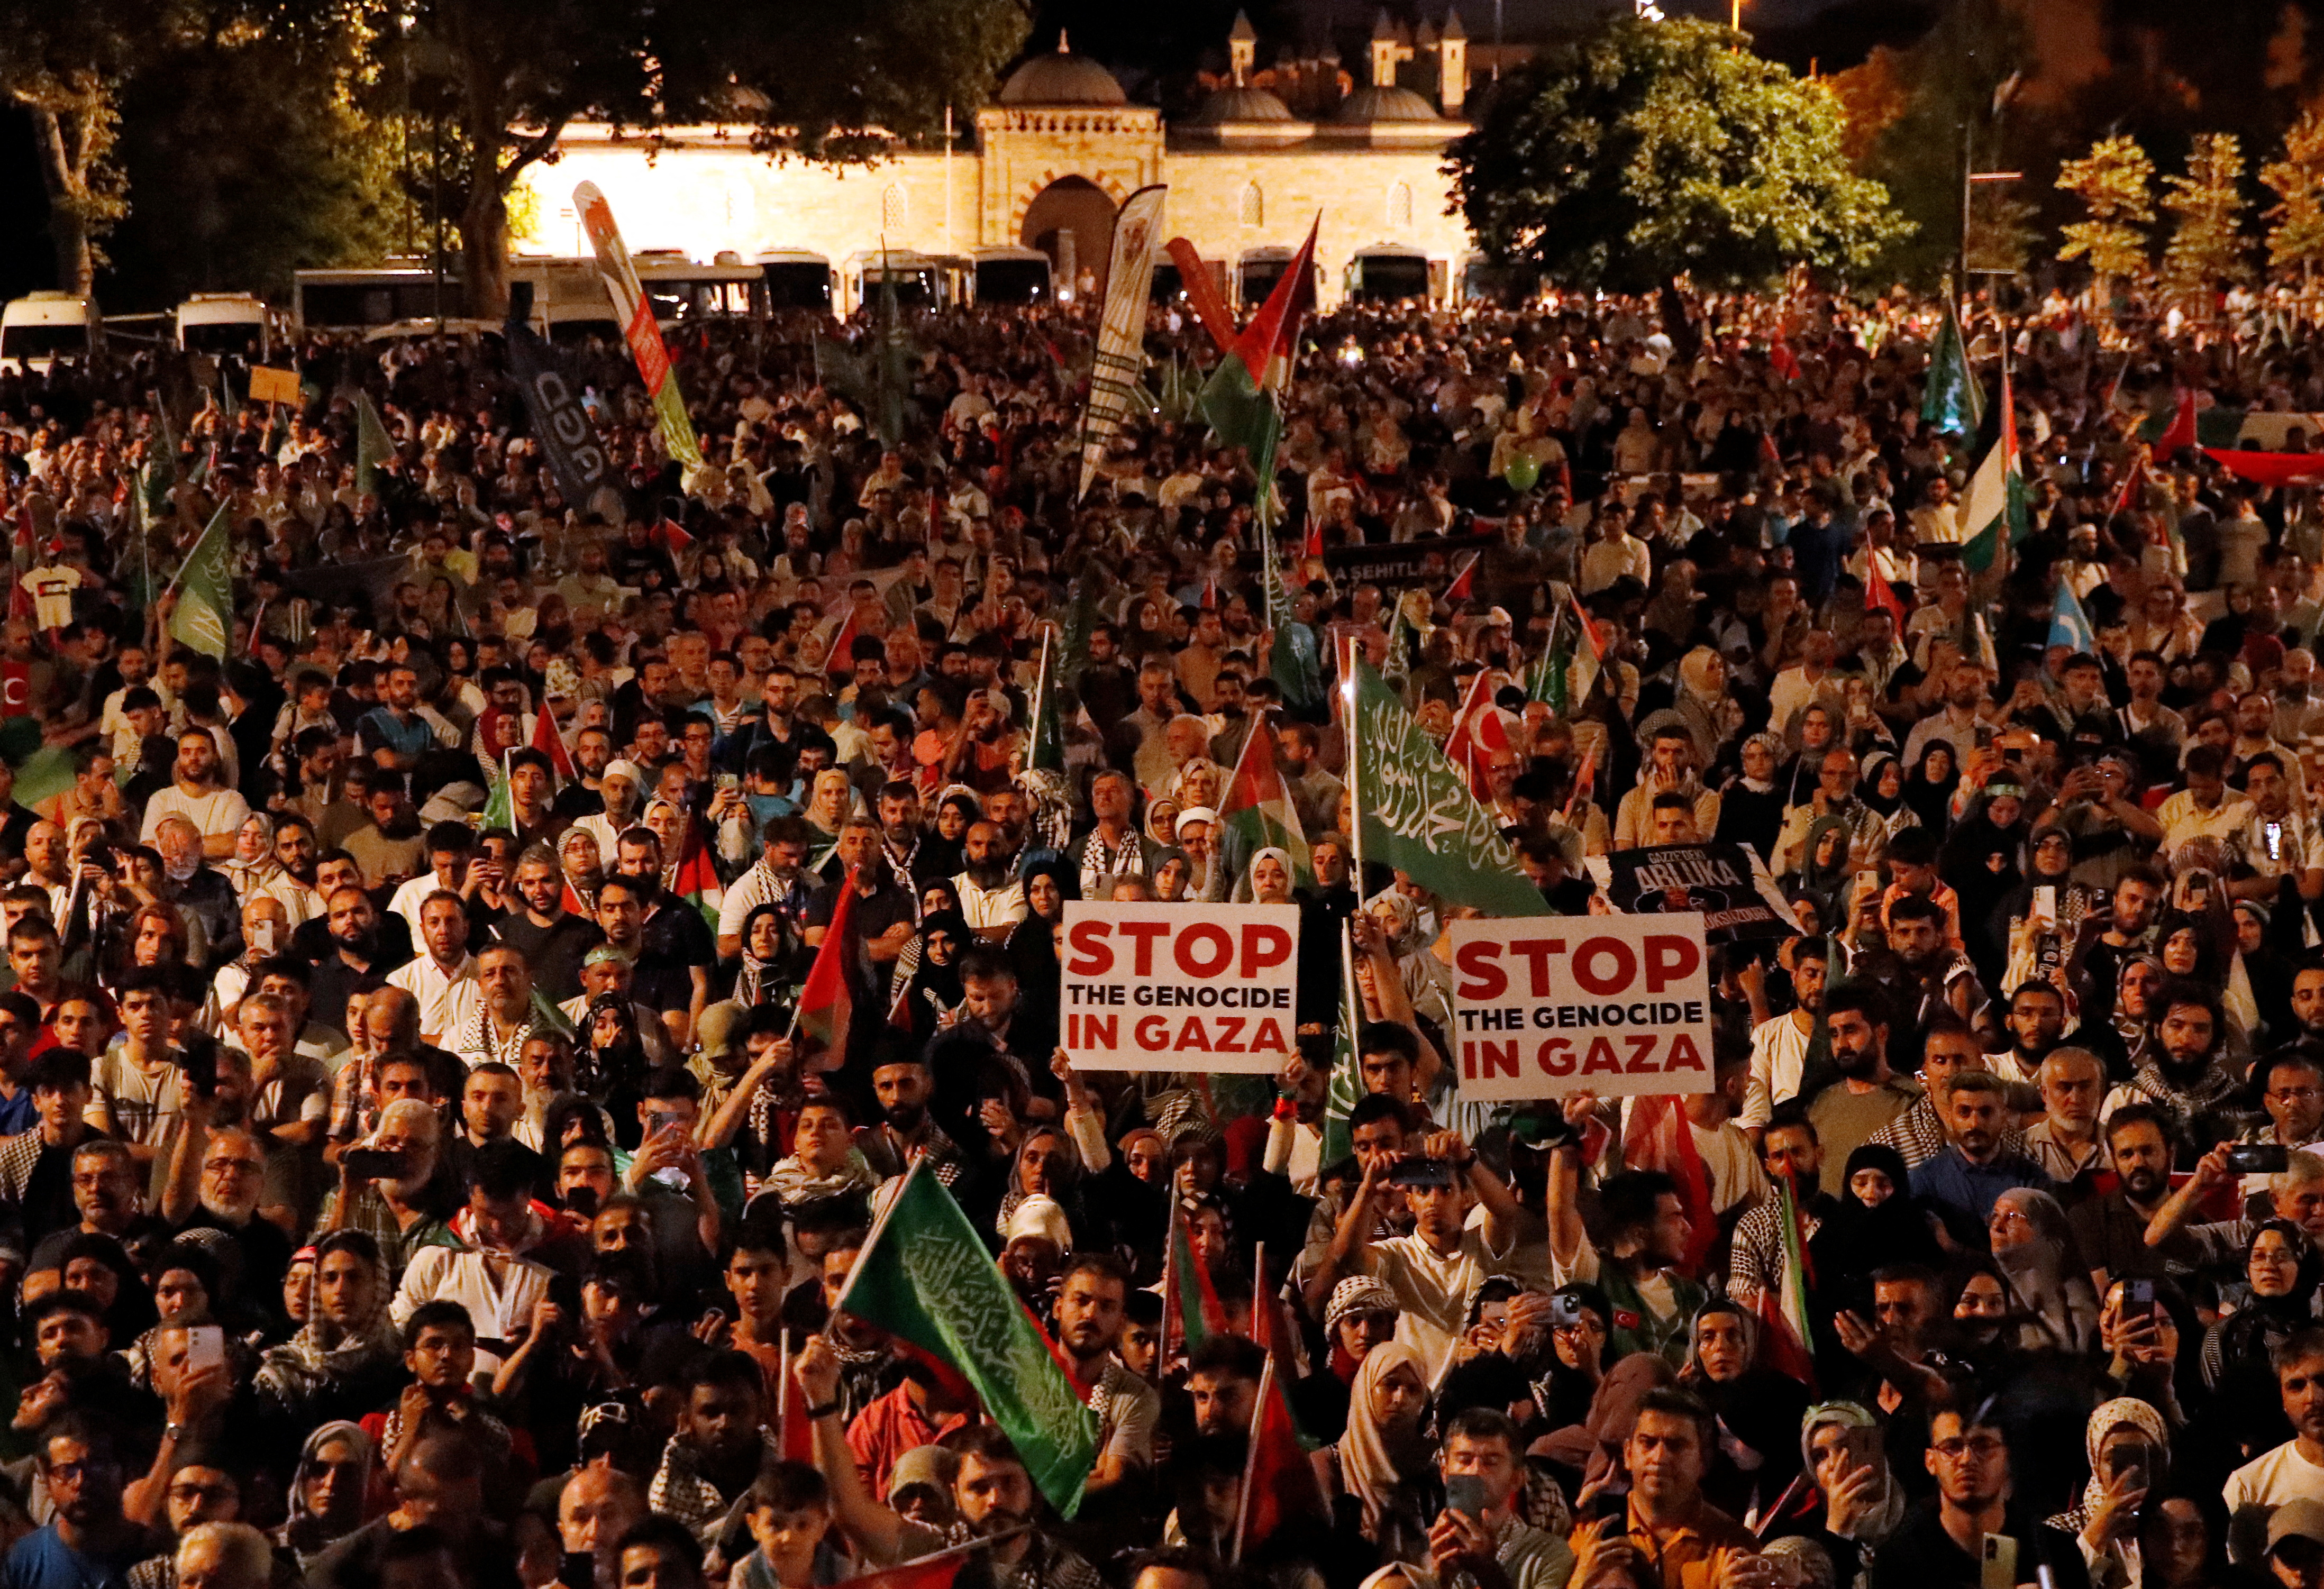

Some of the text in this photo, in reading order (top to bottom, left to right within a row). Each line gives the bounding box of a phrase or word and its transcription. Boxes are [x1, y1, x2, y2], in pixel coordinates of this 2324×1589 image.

[1634, 859, 1743, 893] ABLUKA
[1068, 920, 1292, 978] STOP
[1456, 935, 1700, 1000] STOP
[1067, 984, 1289, 1008] THE GENOCIDE
[1069, 1014, 1288, 1054] IN GAZA
[1459, 1002, 1703, 1031] THE GENOCIDE
[1463, 1034, 1706, 1079] IN GAZA
